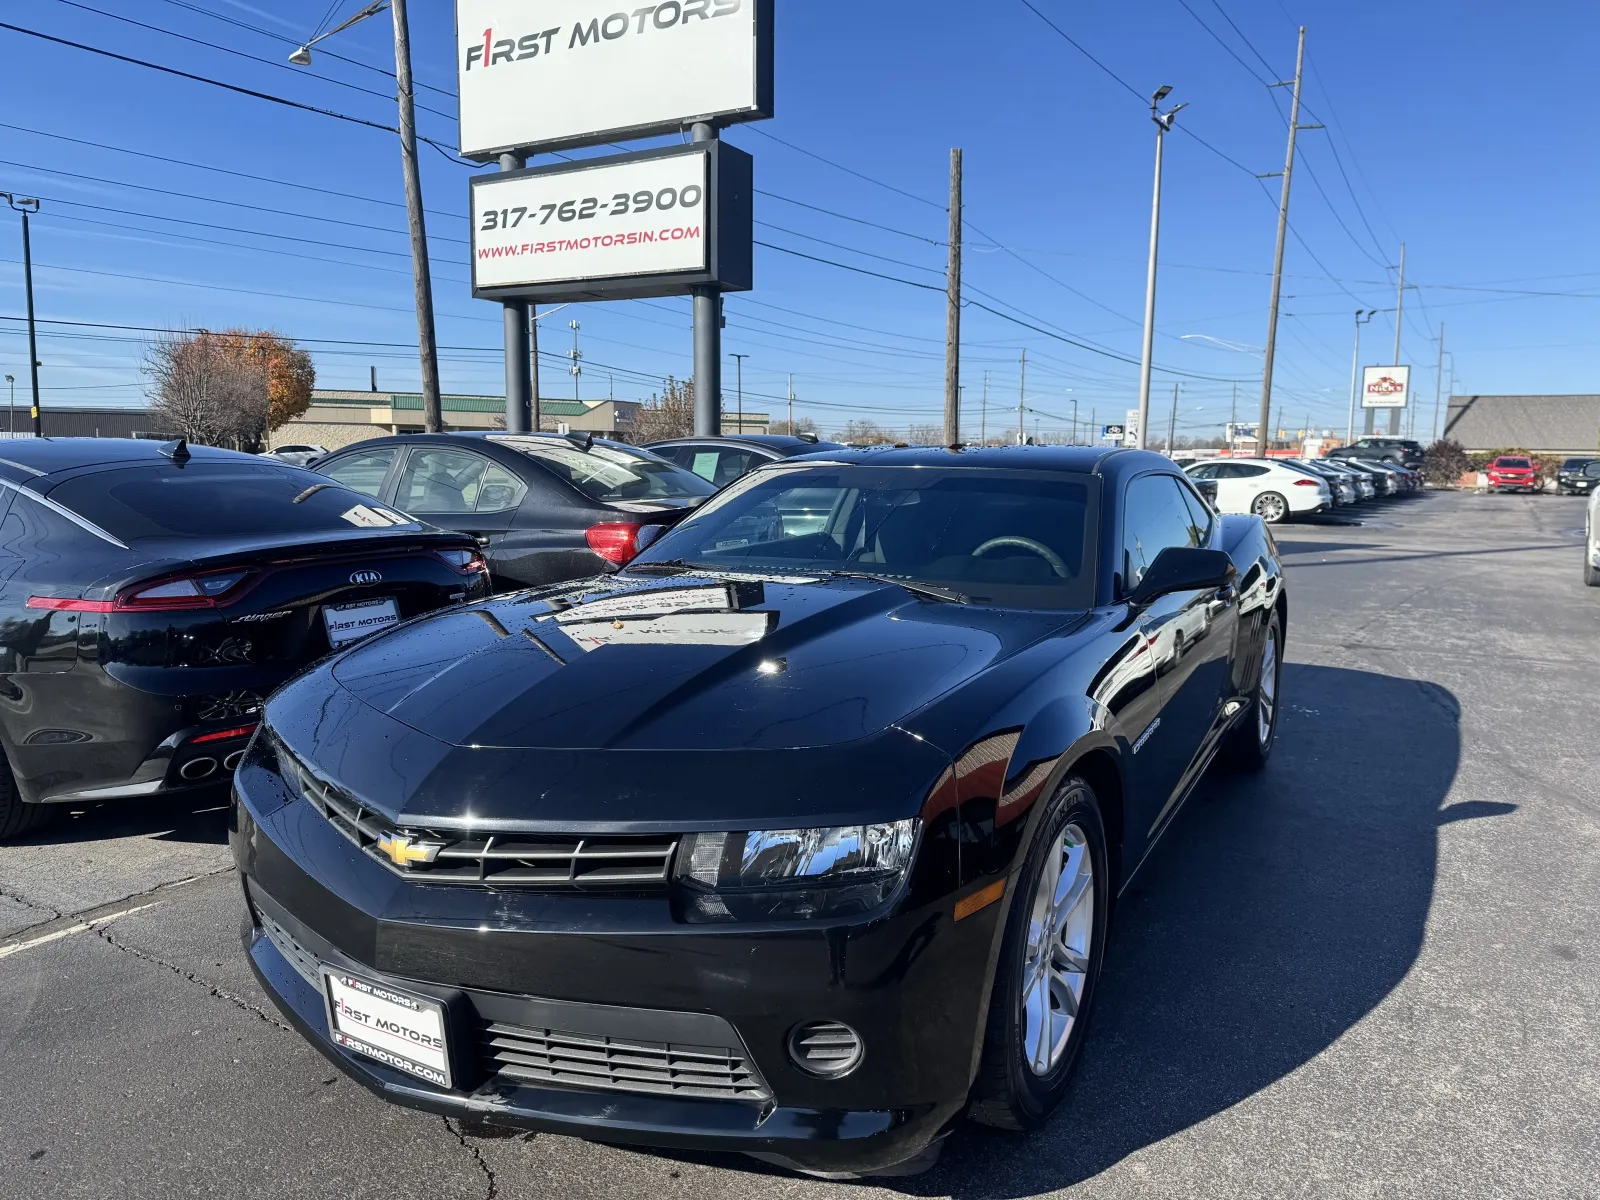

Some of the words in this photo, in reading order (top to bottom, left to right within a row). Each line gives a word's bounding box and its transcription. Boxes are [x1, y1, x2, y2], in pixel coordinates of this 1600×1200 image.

[568, 0, 741, 49] MOTORS
[480, 184, 702, 232] 317-762-3900
[477, 226, 700, 259] WWW.FIRSTMOTORSIN.COM
[355, 571, 377, 584] KIA
[358, 614, 397, 627] MOTORS
[373, 987, 412, 1007] MOTORS
[375, 1017, 443, 1049] MOTORS
